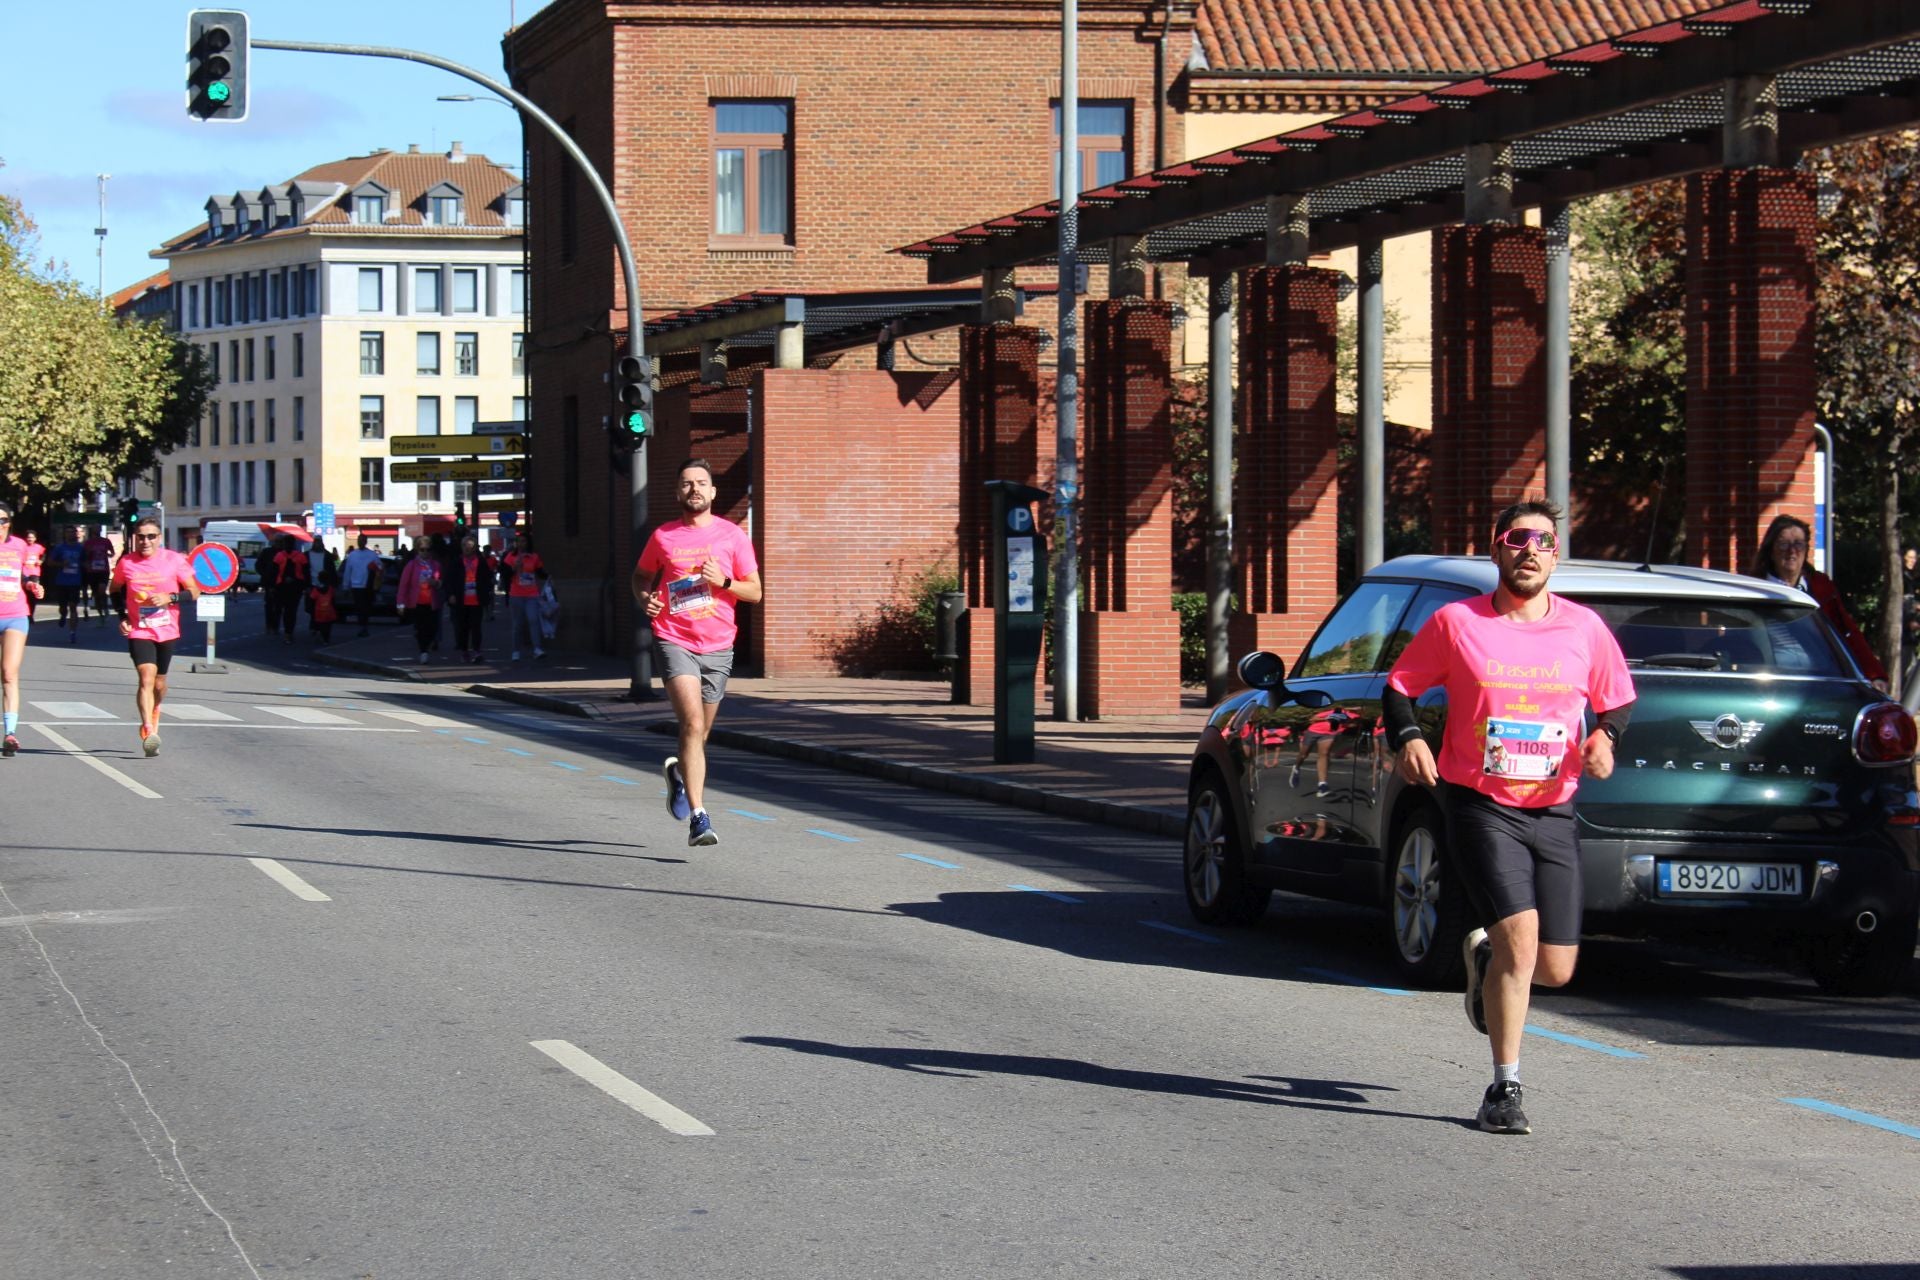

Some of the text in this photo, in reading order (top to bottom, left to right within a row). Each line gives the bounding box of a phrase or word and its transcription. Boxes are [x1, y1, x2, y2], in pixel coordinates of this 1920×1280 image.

[1716, 726, 1741, 736] MINI
[1804, 723, 1839, 735] COOPER
[1516, 741, 1549, 755] 1108
[1635, 759, 1816, 775] PACEMAN
[1678, 865, 1797, 892] 8920 JDM
